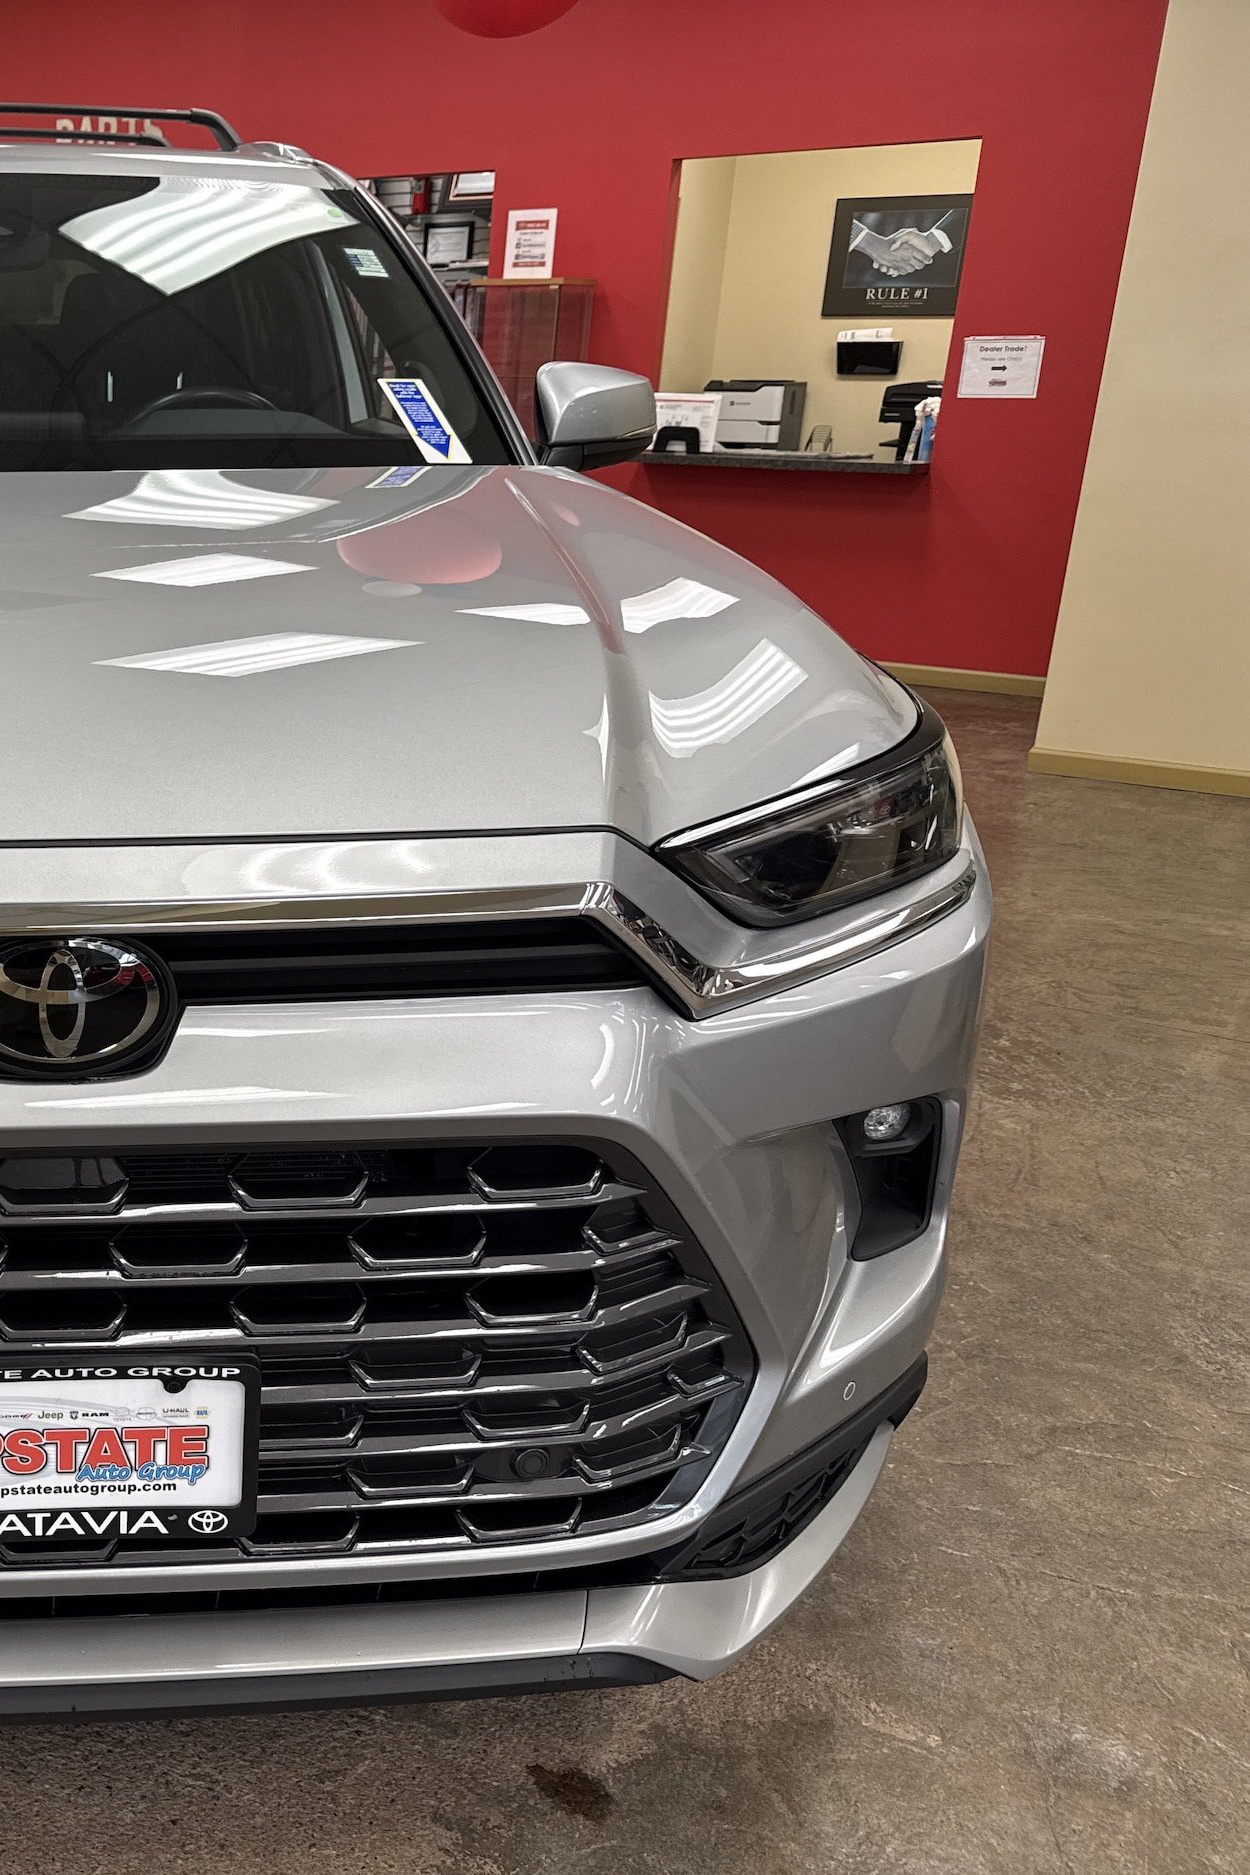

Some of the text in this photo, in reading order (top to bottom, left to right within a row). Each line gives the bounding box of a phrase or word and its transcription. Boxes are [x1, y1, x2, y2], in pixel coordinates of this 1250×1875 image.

[865, 287, 929, 300] RULE #1
[30, 1367, 117, 1380] AUTO
[127, 1366, 241, 1379] GROUP
[38, 1410, 64, 1421] Jeep
[76, 1461, 207, 1486] Auto Group
